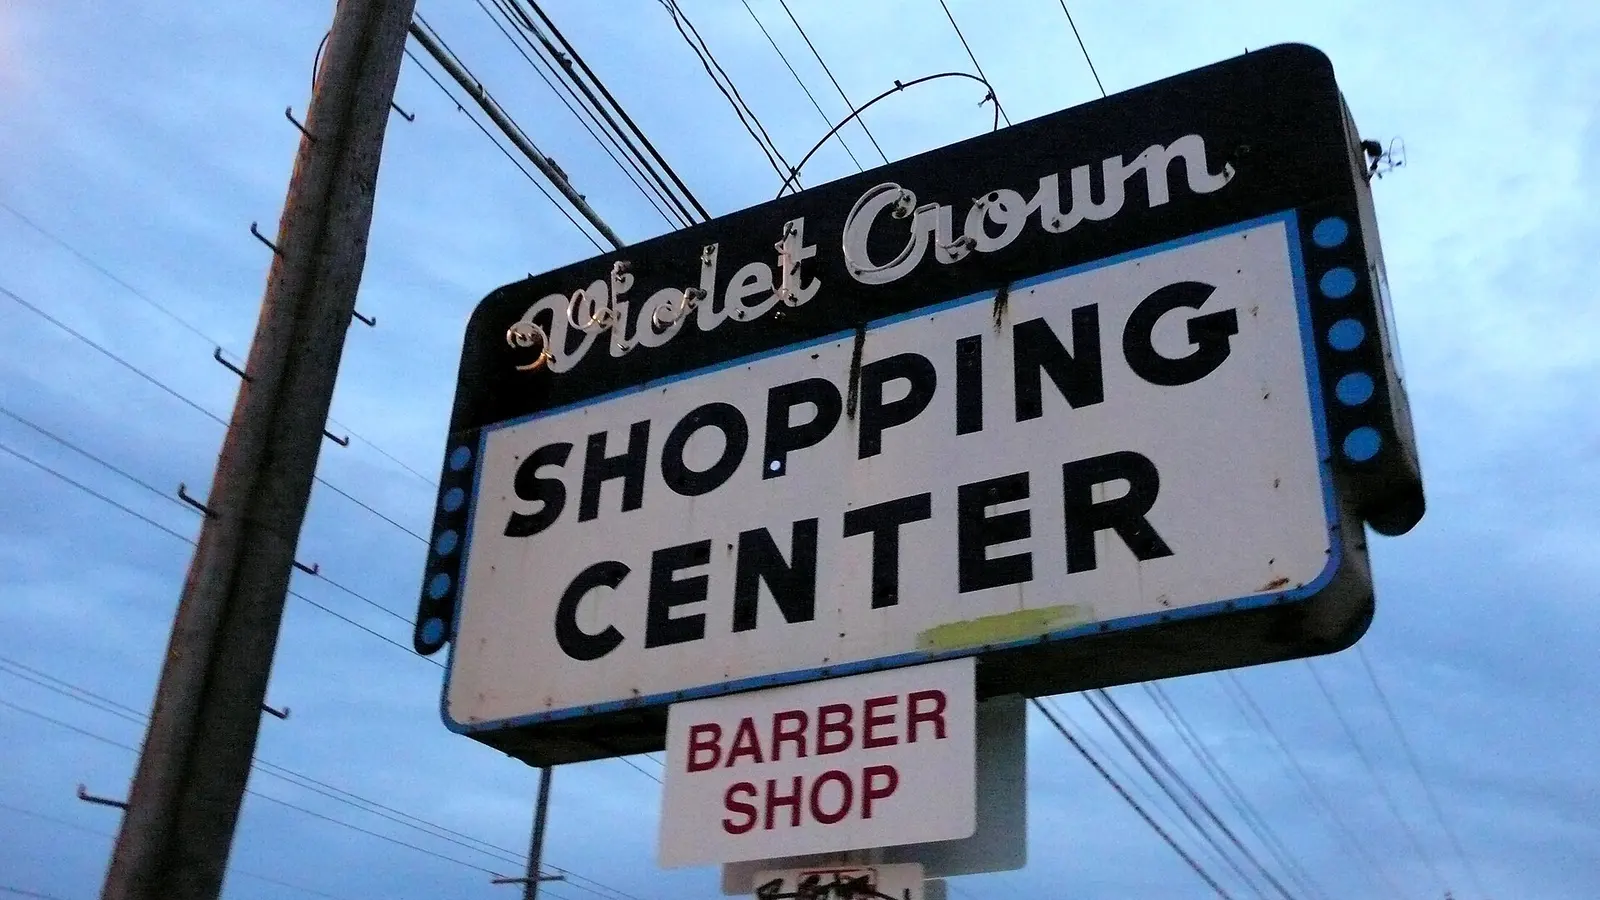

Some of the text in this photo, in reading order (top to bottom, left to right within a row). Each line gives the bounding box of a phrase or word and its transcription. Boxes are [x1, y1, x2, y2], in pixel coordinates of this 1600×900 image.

[506, 134, 1236, 373] Violet Crown
[503, 281, 1238, 537] SHOPPING
[555, 451, 1174, 661] CENTER
[686, 689, 948, 773] BARBER
[721, 764, 899, 834] SHOP
